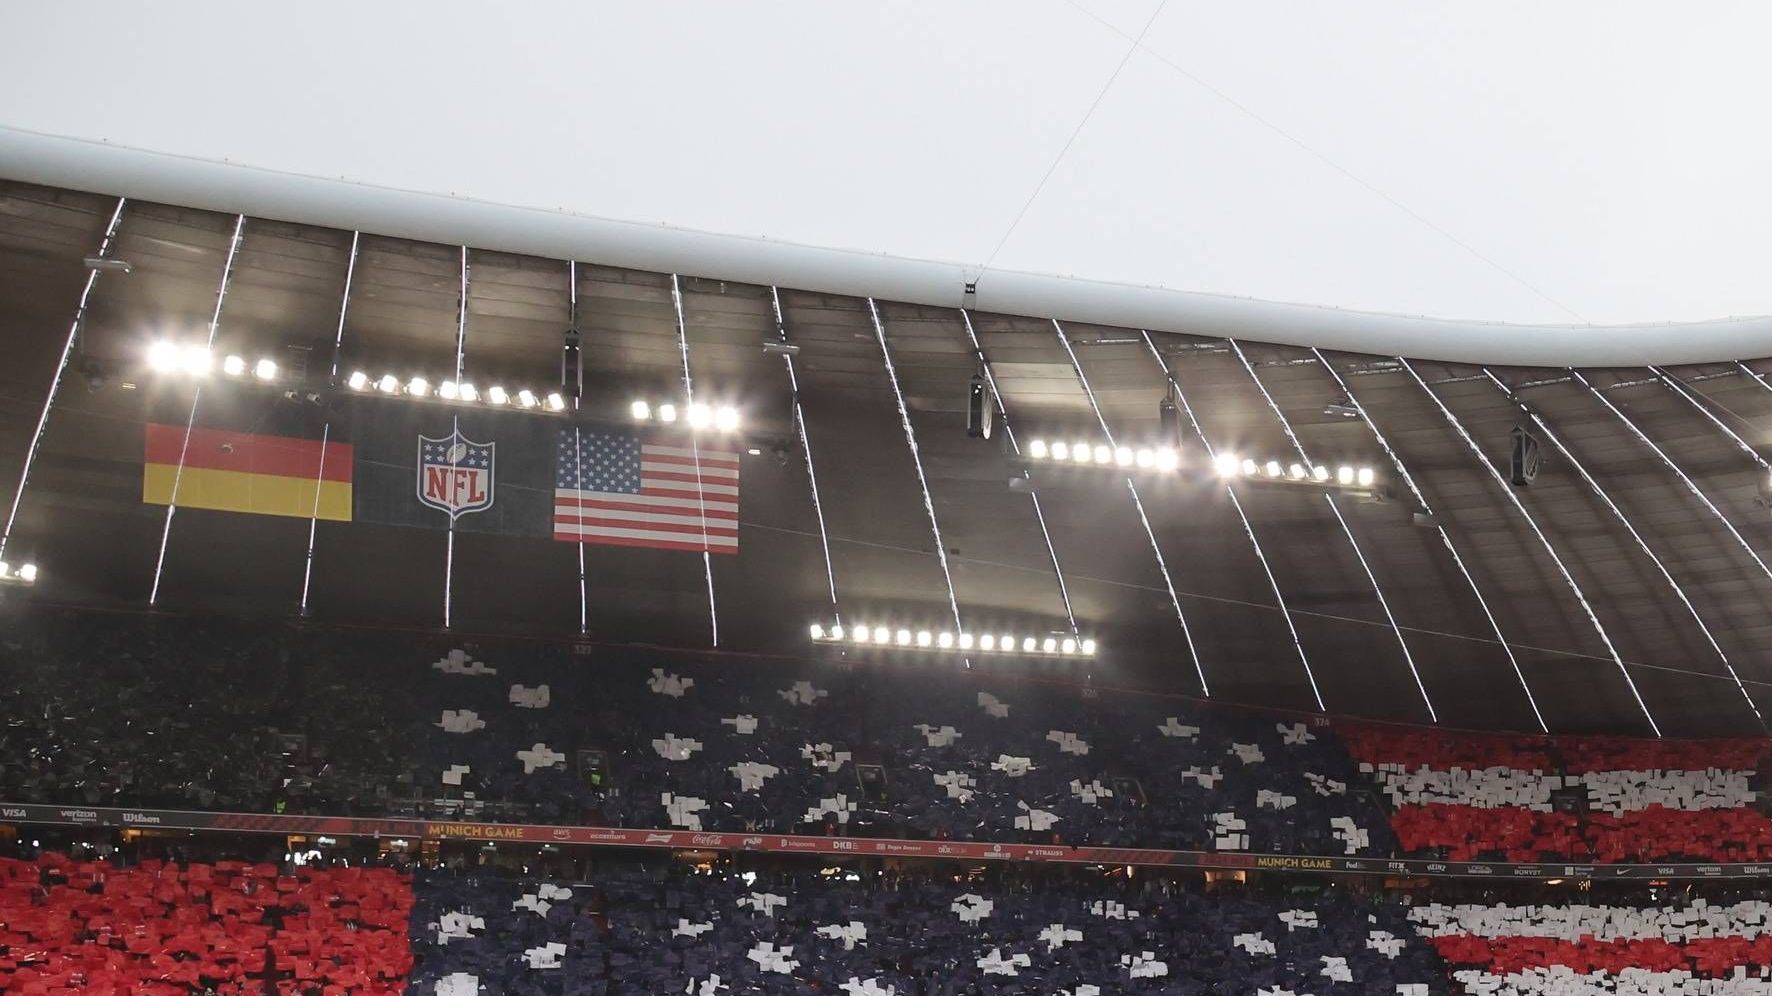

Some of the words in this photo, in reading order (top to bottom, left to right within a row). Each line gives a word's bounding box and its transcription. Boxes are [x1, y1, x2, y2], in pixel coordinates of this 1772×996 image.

[427, 466, 486, 504] NFL
[2, 808, 27, 818] VISA
[61, 809, 97, 819] verizon
[122, 812, 160, 824] Wilson
[428, 825, 482, 838] MUNICH
[485, 826, 525, 839] GAME
[1257, 856, 1299, 869] MUNICH
[1301, 857, 1332, 870] GAME
[1658, 866, 1675, 875] VISA
[1744, 865, 1770, 875] Wilson
